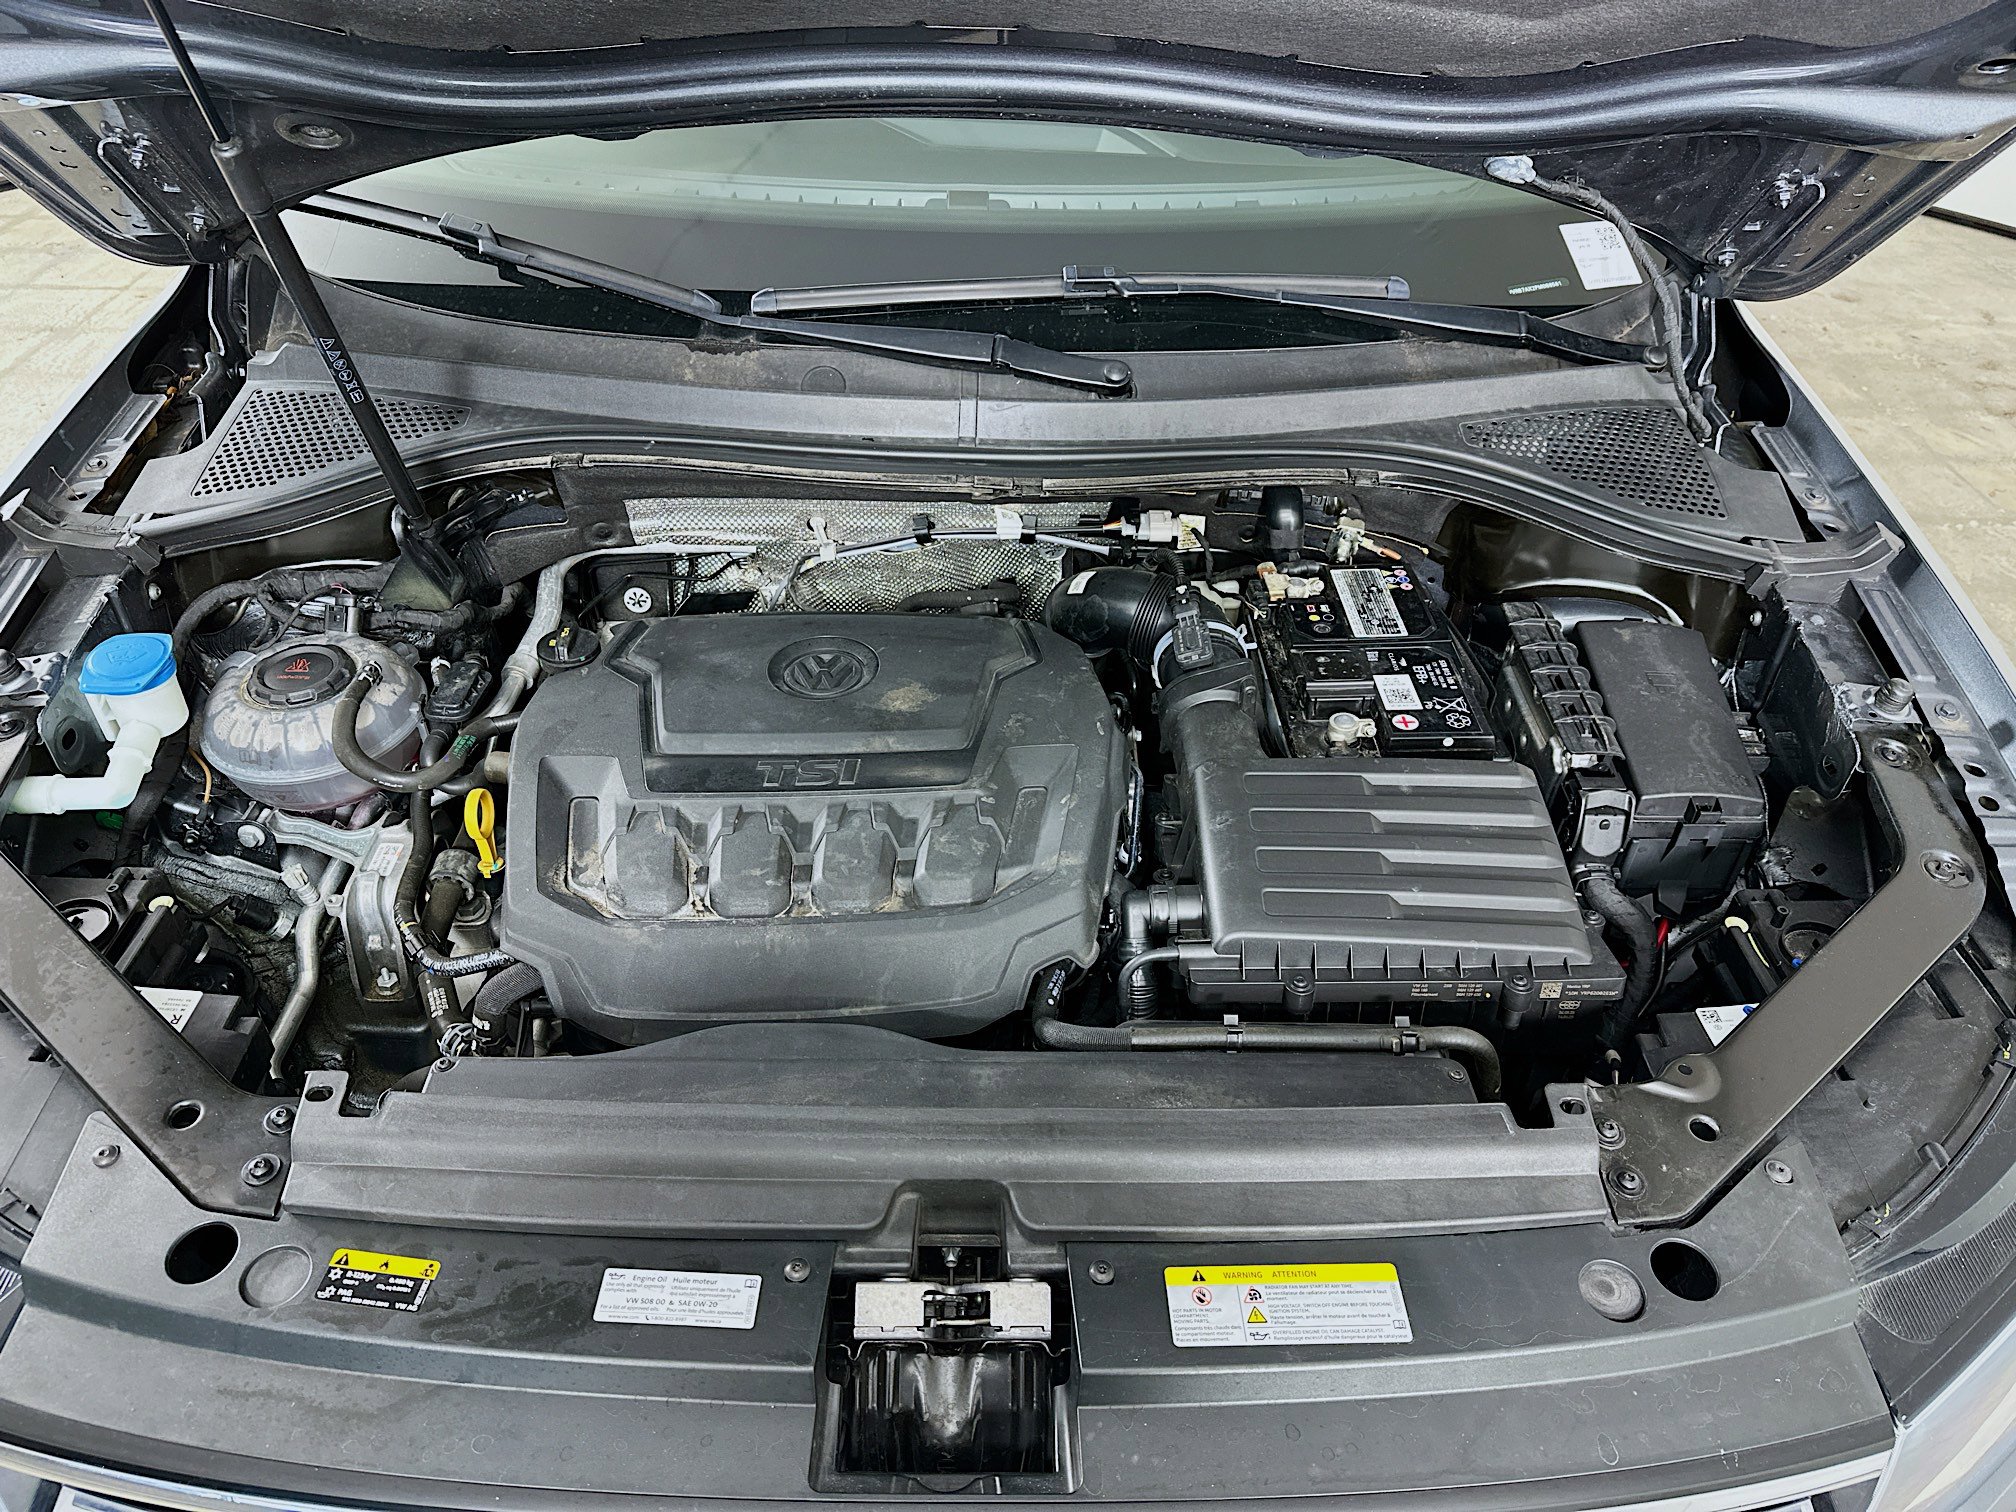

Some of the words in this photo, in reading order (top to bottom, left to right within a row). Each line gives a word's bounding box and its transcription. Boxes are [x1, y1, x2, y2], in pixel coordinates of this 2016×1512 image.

[1388, 652, 1400, 671] CLARIOS
[1412, 666, 1428, 684] EFB+
[756, 758, 861, 787] TSI
[170, 1014, 182, 1024] R
[633, 1275, 655, 1283] Engine
[1223, 1270, 1263, 1279] WARNING
[1272, 1270, 1317, 1278] ATTENTION
